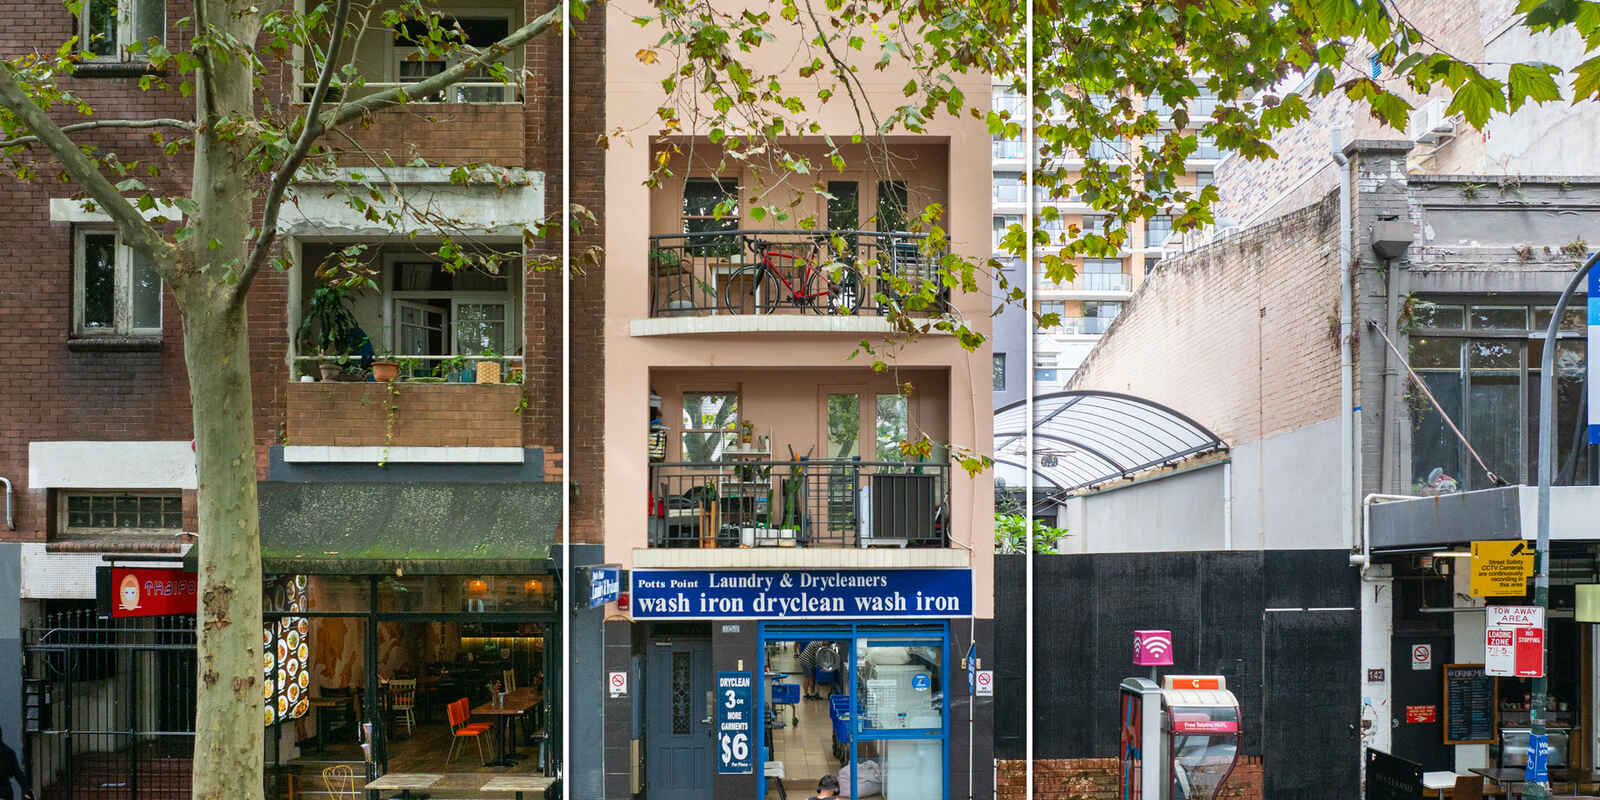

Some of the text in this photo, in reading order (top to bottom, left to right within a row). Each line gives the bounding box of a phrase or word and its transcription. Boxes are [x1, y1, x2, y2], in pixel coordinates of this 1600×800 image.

[638, 572, 888, 592] Potts Point Laundry & Drycleaners
[638, 591, 960, 617] wash iron dryclean wash iron
[1490, 638, 1510, 646] ZONE
[720, 677, 750, 688] DRYCLEAN
[725, 690, 736, 709] 3
[727, 712, 742, 720] MORE
[721, 722, 748, 731] GARMENTS
